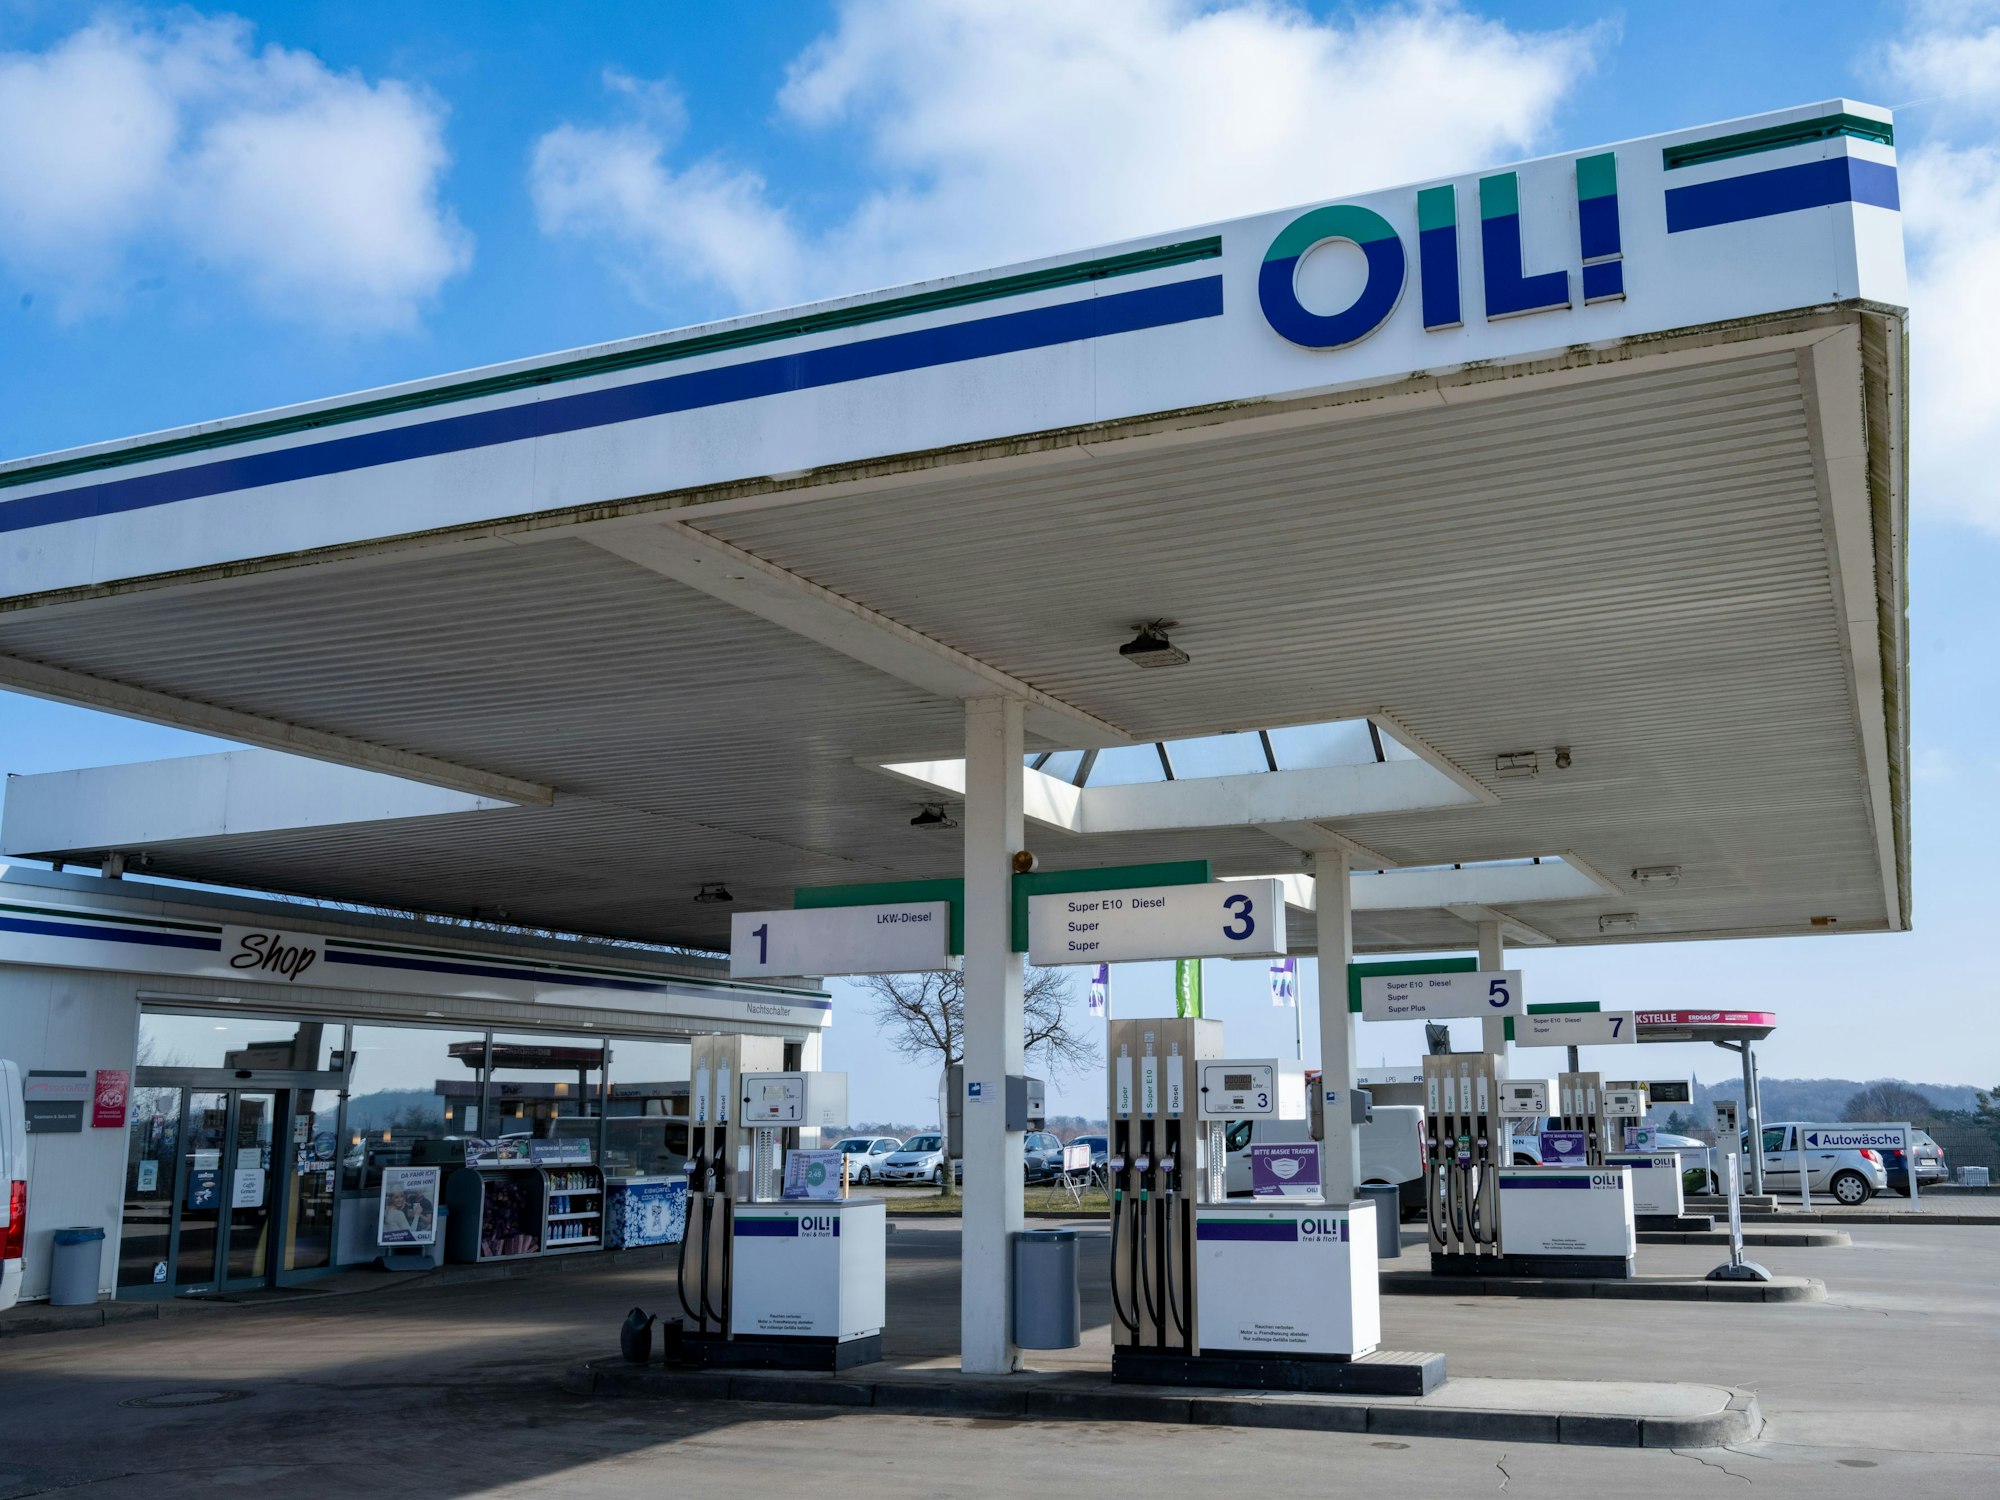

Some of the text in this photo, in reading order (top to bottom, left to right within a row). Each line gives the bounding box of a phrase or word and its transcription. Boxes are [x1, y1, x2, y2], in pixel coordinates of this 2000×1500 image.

[1258, 152, 1626, 352] OIL!
[1068, 897, 1165, 913] Super E10 Diesel
[877, 912, 931, 924] LKW-Diesel
[1223, 894, 1255, 941] 3
[1068, 921, 1099, 932] Super
[752, 923, 768, 964] 1
[1068, 940, 1099, 951] Super
[230, 934, 316, 982] Shop
[1429, 979, 1451, 987] Diesel
[1387, 993, 1408, 1001] Super
[1488, 979, 1510, 1008] 5
[746, 1003, 791, 1016] Nachtschalter
[1388, 1005, 1409, 1013] Super
[1636, 1012, 1677, 1024] KSTELLE
[1608, 1017, 1624, 1038] 7
[1257, 1093, 1268, 1108] 3
[1535, 1101, 1543, 1110] 5
[789, 1105, 795, 1118] 1
[1823, 1133, 1900, 1145] Autowäsche
[1592, 1175, 1615, 1185] OIL!
[801, 1216, 829, 1230] OIL!
[1301, 1218, 1337, 1234] OIL!
